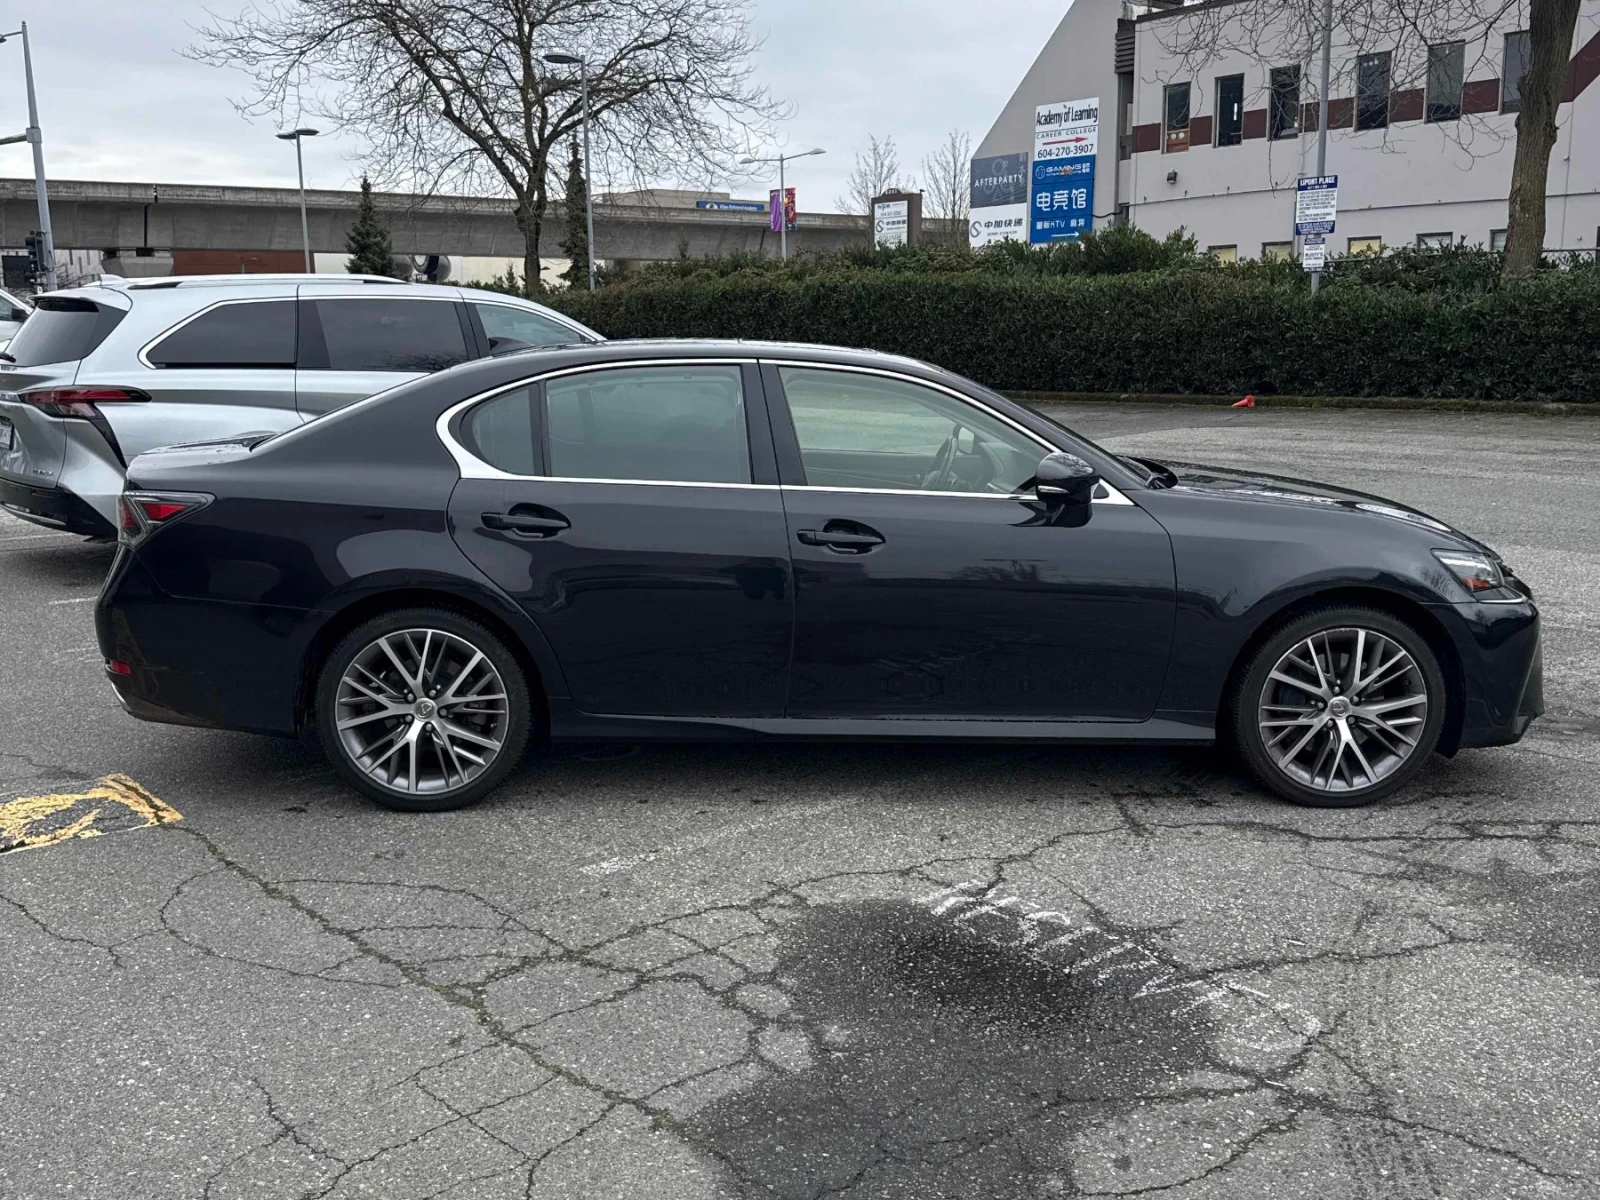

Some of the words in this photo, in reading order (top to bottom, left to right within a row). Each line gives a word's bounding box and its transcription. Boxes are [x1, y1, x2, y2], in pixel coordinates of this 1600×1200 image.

[1036, 110, 1063, 127] Academy
[1063, 107, 1071, 123] of
[1071, 104, 1098, 123] Learning
[1036, 131, 1062, 139] CAREER
[1066, 127, 1097, 135] COLLEGE
[1037, 144, 1094, 159] 604-270-3907
[1046, 164, 1082, 173] GAMING
[974, 174, 1023, 187] AFTERPARTY
[1318, 176, 1335, 184] PLACE
[1036, 188, 1087, 211] 电竞馆
